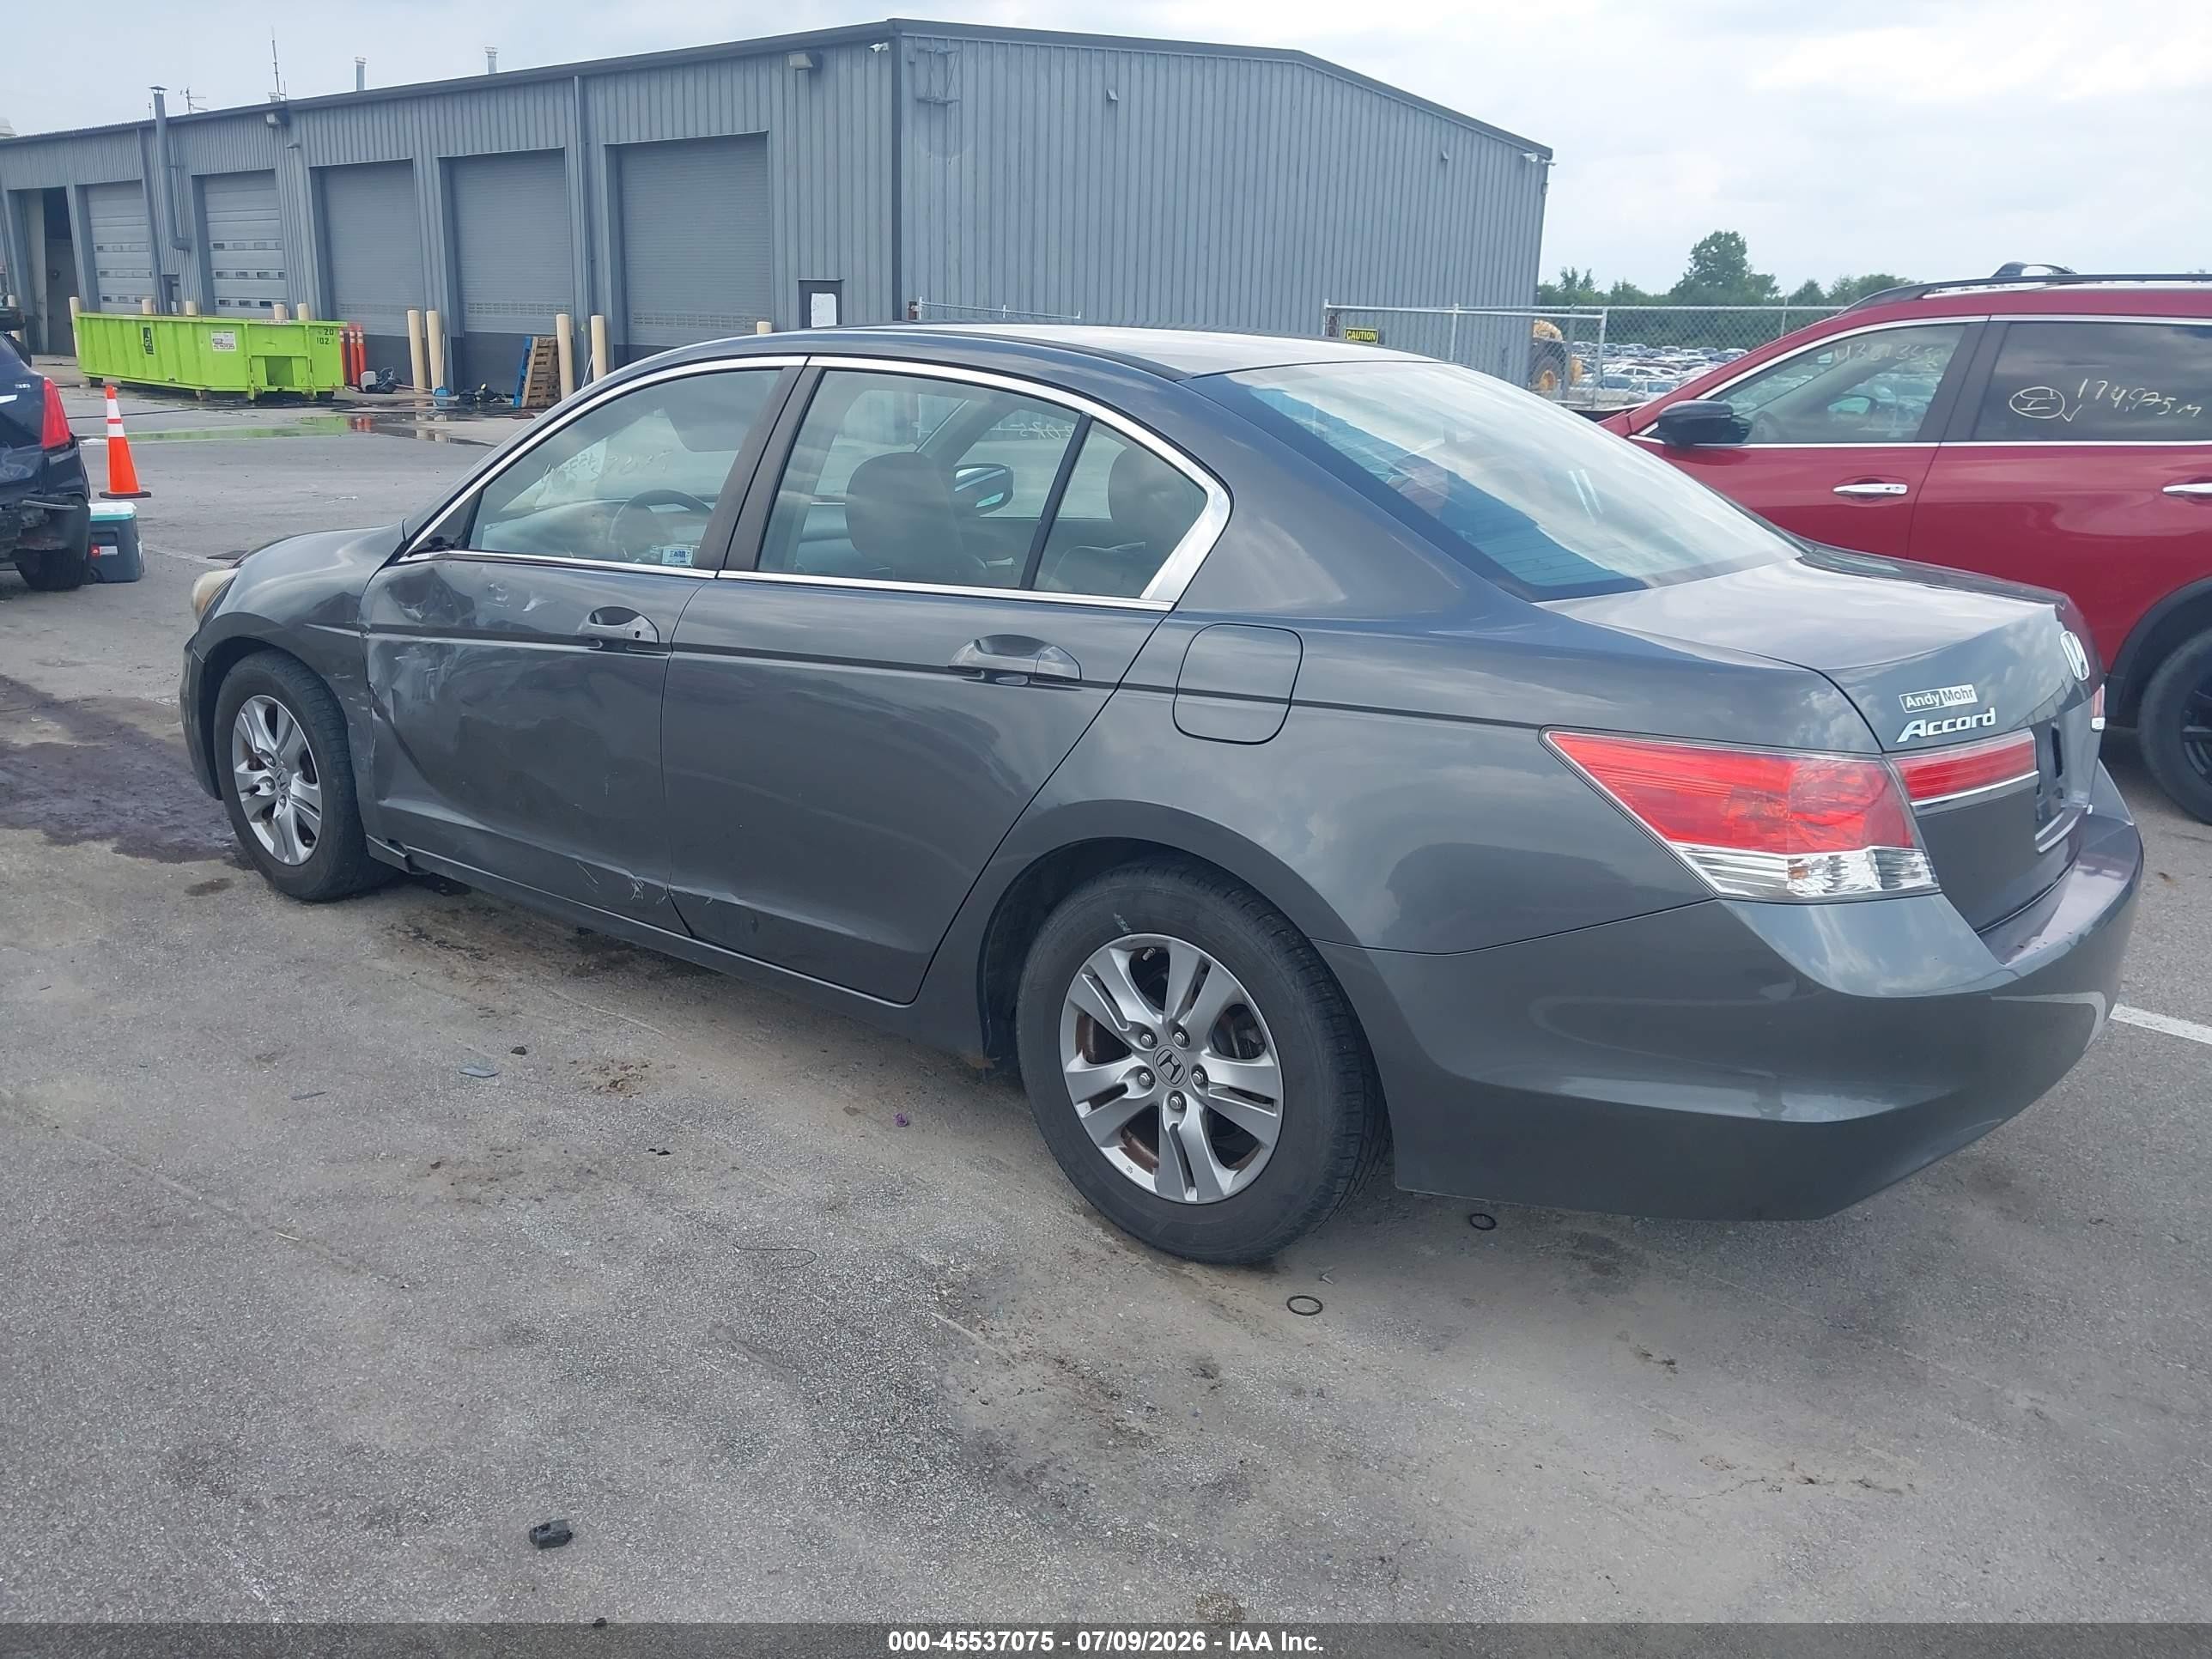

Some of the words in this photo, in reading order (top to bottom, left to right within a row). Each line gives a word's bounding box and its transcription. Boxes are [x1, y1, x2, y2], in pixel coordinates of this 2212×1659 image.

[1346, 330, 1376, 341] CAUTION
[1906, 691, 1941, 709] Andy
[1942, 686, 1974, 702] Mohr
[1895, 708, 1996, 744] Accord
